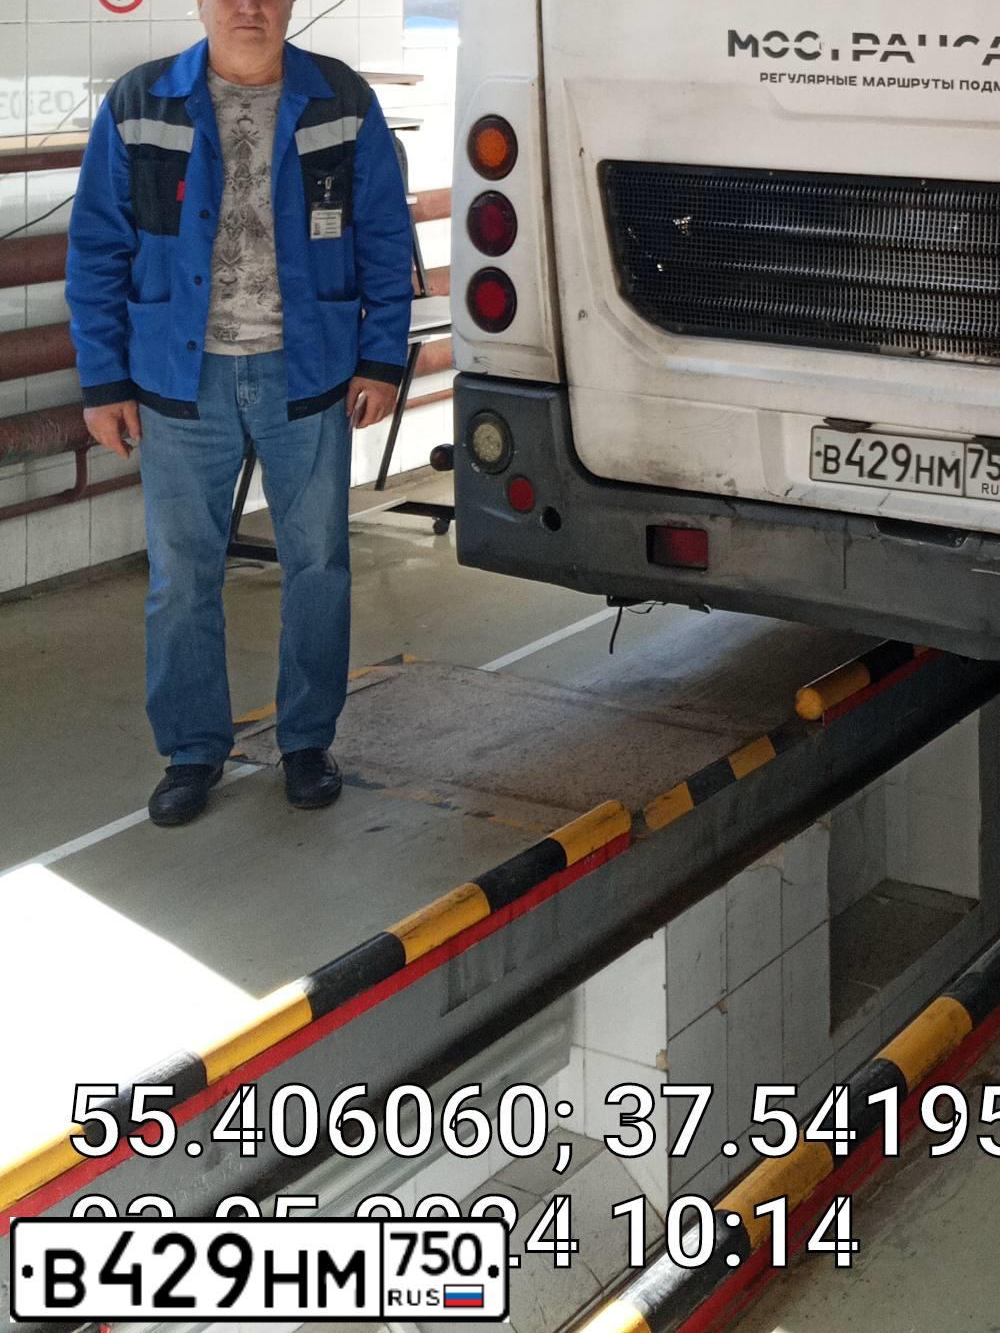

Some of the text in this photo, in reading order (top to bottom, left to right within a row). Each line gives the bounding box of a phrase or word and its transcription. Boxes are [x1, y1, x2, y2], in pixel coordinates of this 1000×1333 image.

[759, 72, 858, 87] РЕГУЛЯРНЫЕ
[862, 76, 954, 90] МАРШРУТЫ
[822, 438, 961, 489] В429НМ
